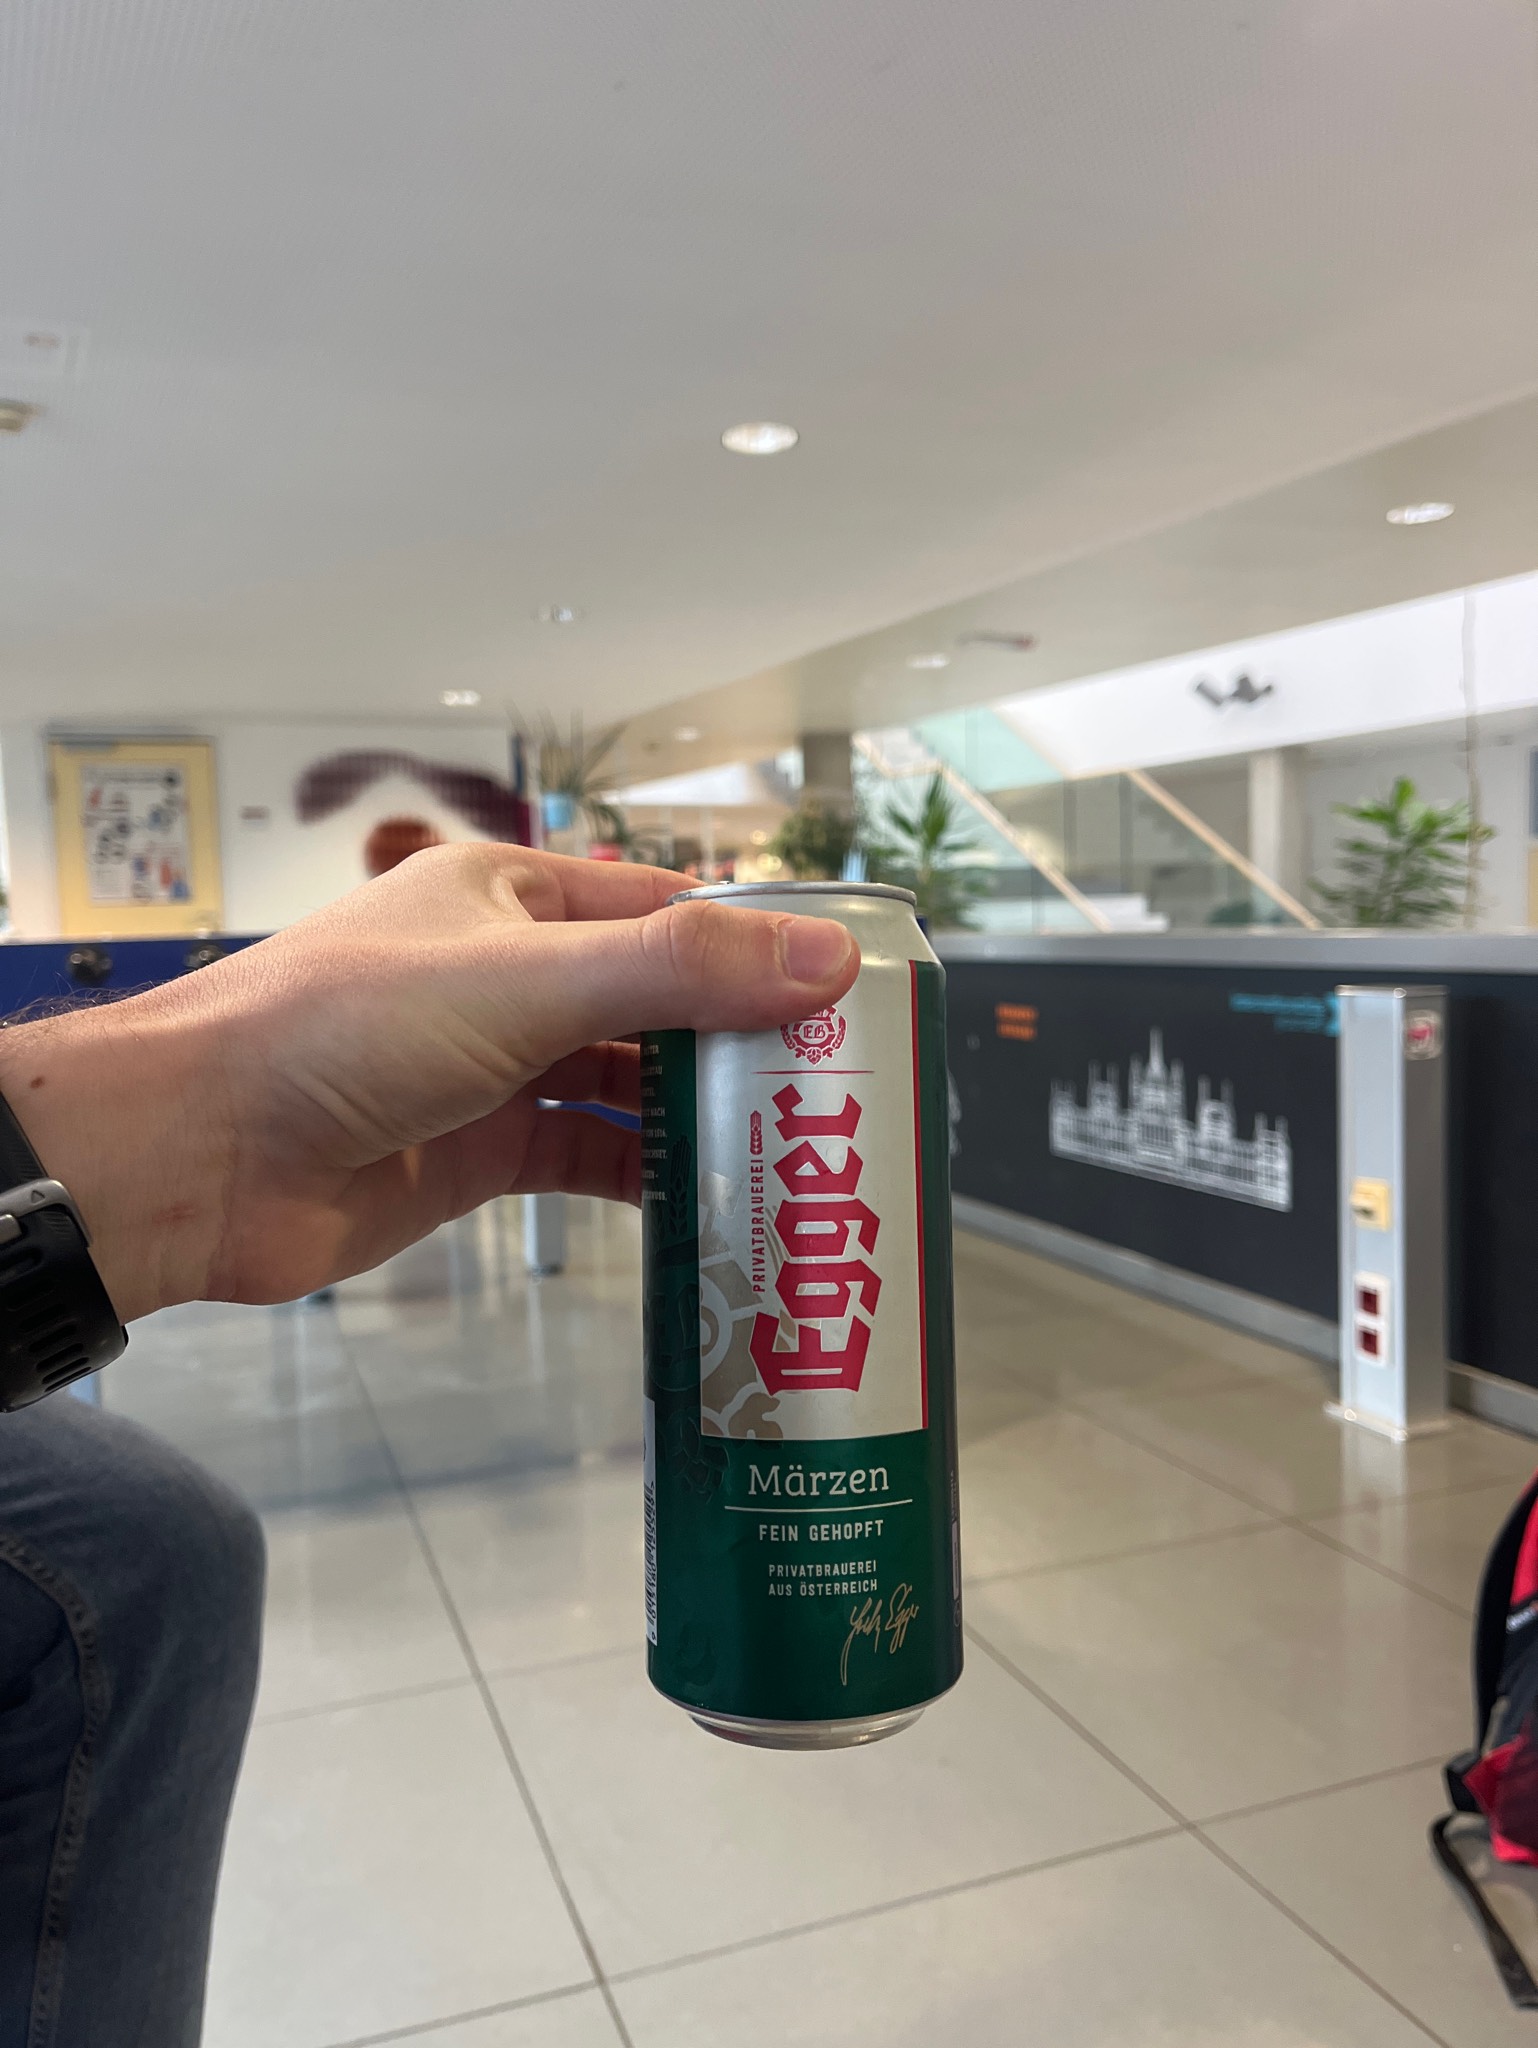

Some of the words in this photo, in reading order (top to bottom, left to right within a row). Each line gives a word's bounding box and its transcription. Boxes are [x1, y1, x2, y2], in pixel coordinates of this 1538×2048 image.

[803, 1024, 826, 1039] EB
[750, 1158, 766, 1293] PRIVATBRAUEREI
[749, 1082, 883, 1396] Egger
[748, 1464, 890, 1497] Märzen
[759, 1524, 799, 1542] FEIN
[809, 1519, 884, 1542] GEHOPFT
[768, 1559, 878, 1578] PRIVATBRAUEREI
[768, 1583, 793, 1597] AUS
[800, 1578, 878, 1597] ÖSTERREICH
